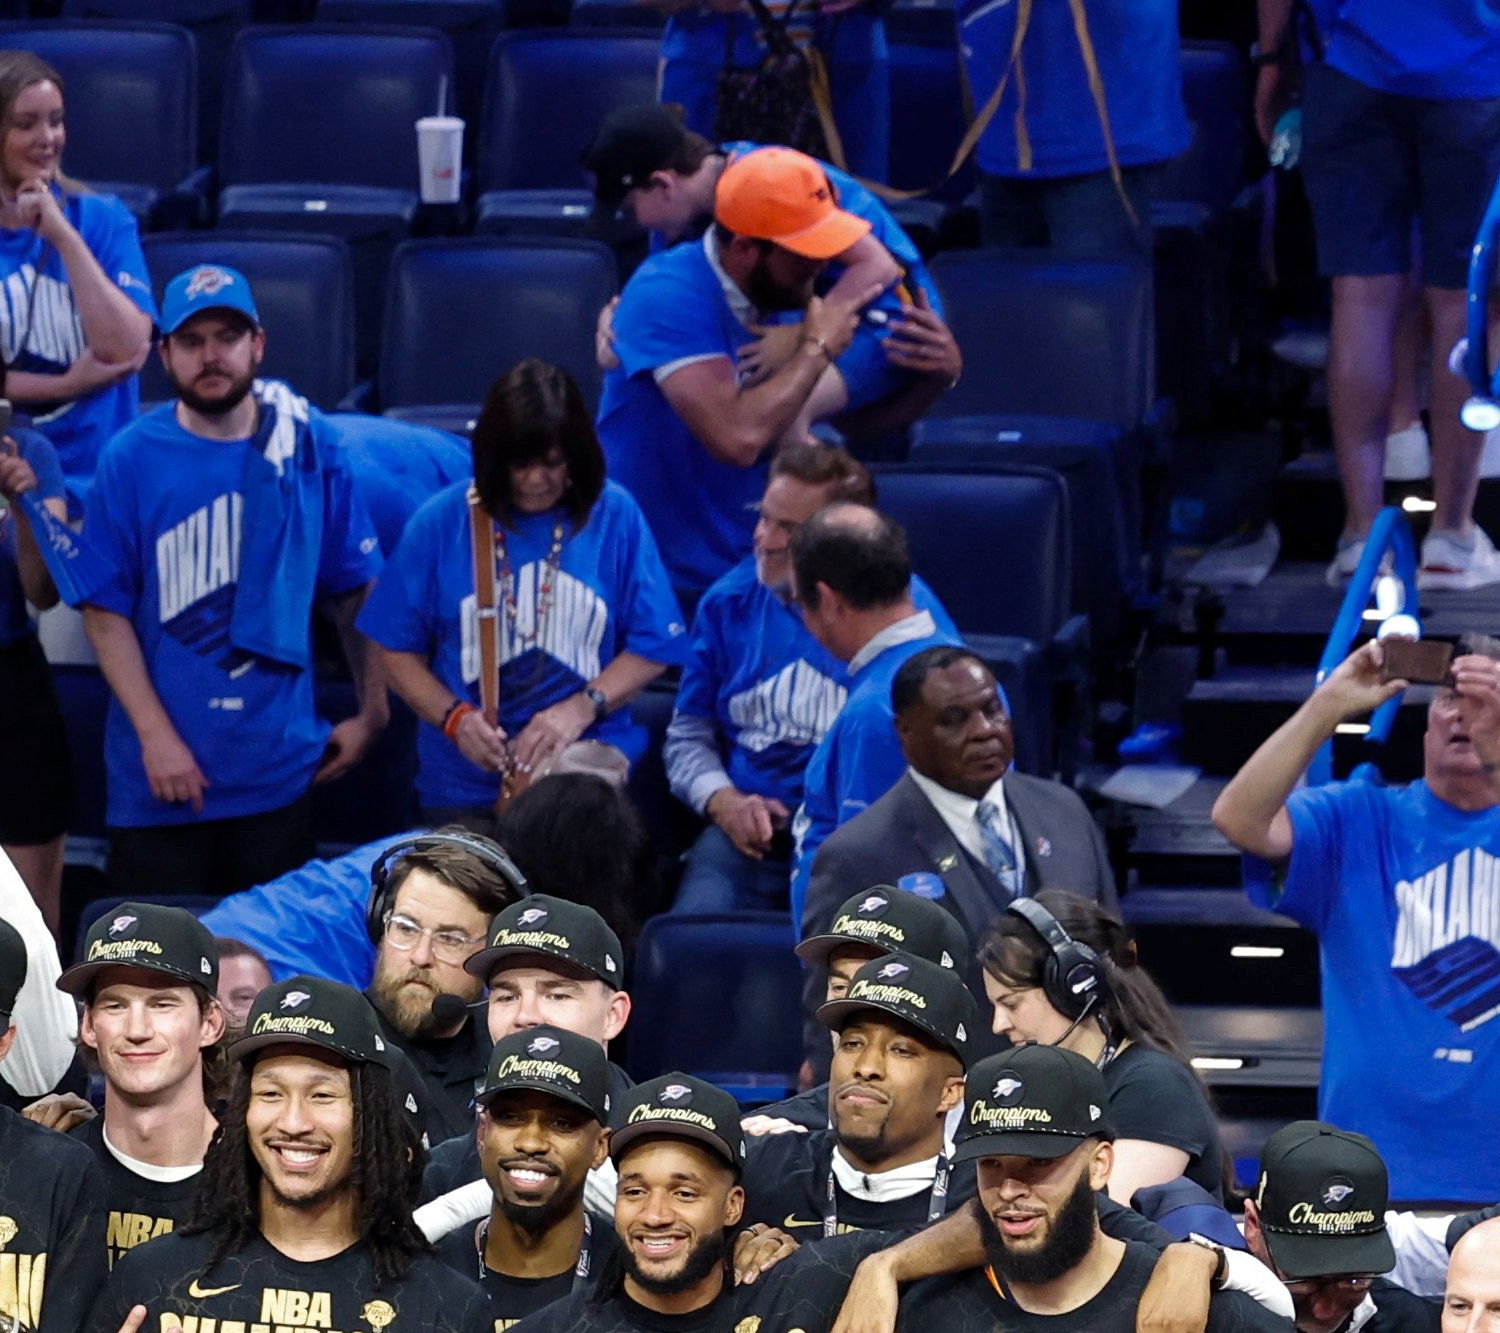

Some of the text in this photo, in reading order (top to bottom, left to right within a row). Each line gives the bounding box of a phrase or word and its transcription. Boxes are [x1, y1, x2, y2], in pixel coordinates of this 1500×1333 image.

[155, 492, 243, 622] OKLA
[833, 915, 904, 940] Champions
[88, 938, 162, 959] Champions
[850, 980, 927, 1008] Champions
[253, 1012, 334, 1034] Champions
[498, 1054, 580, 1083] Champions
[629, 1104, 716, 1129] Champions
[970, 1101, 1051, 1123] Champions
[1289, 1203, 1374, 1225] Champions
[260, 1288, 331, 1327] NBA
